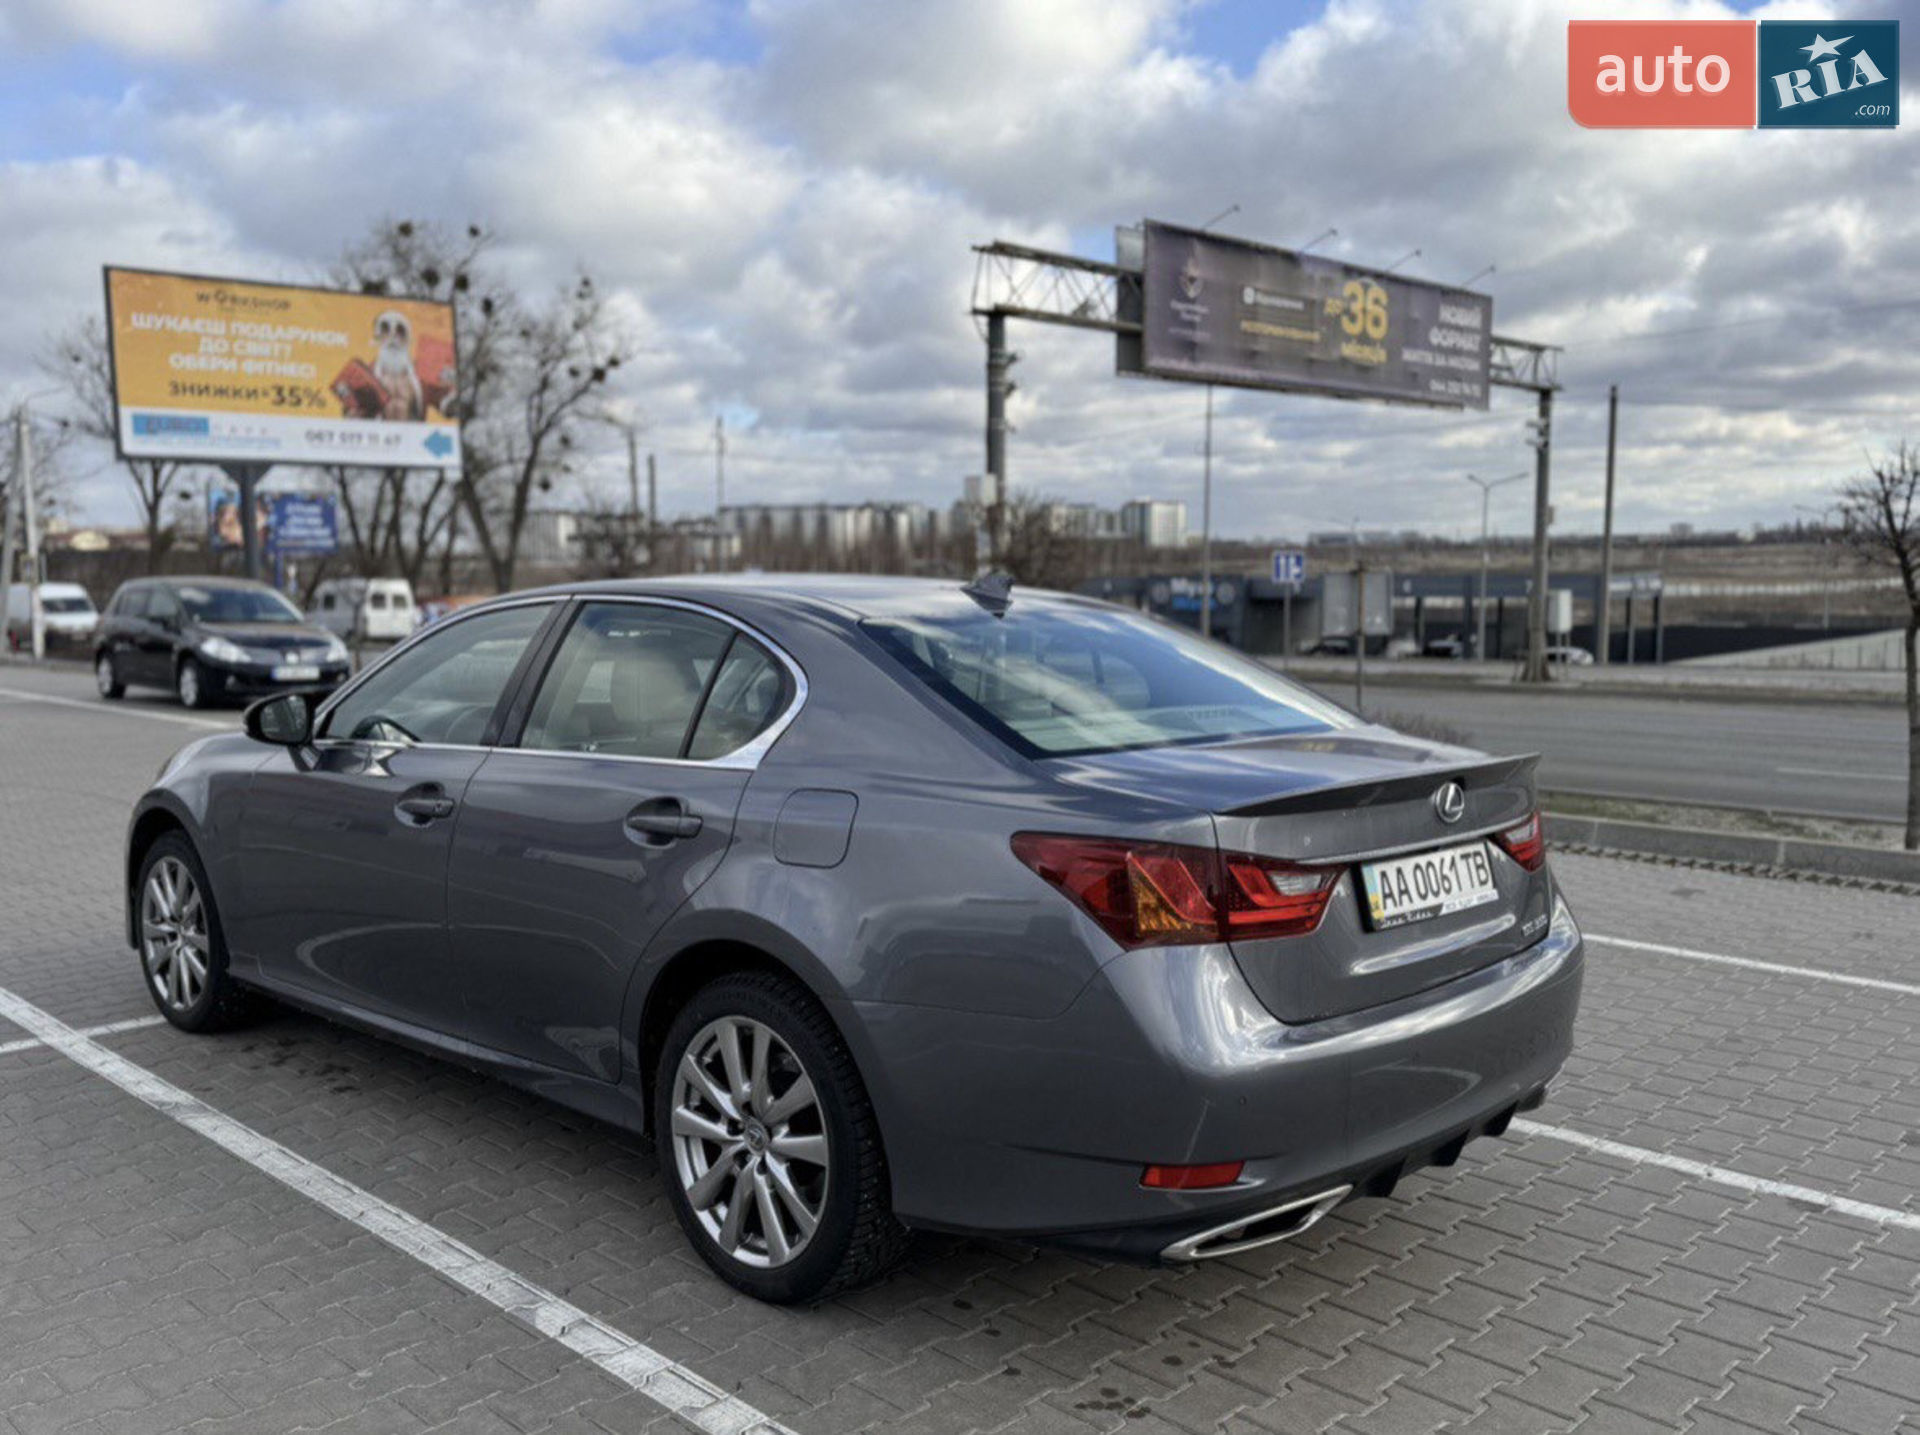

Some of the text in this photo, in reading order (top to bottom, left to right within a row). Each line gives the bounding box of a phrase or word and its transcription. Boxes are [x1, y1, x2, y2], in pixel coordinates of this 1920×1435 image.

[1341, 280, 1388, 340] 36
[231, 321, 349, 346] ПОДАРУНОК
[198, 336, 230, 355] ДО
[169, 352, 238, 373] ОБЕРИ
[168, 381, 259, 400] ЗНИЖКИ
[1379, 866, 1414, 910] AA
[1413, 855, 1463, 901] 0061
[1460, 850, 1489, 889] TB
